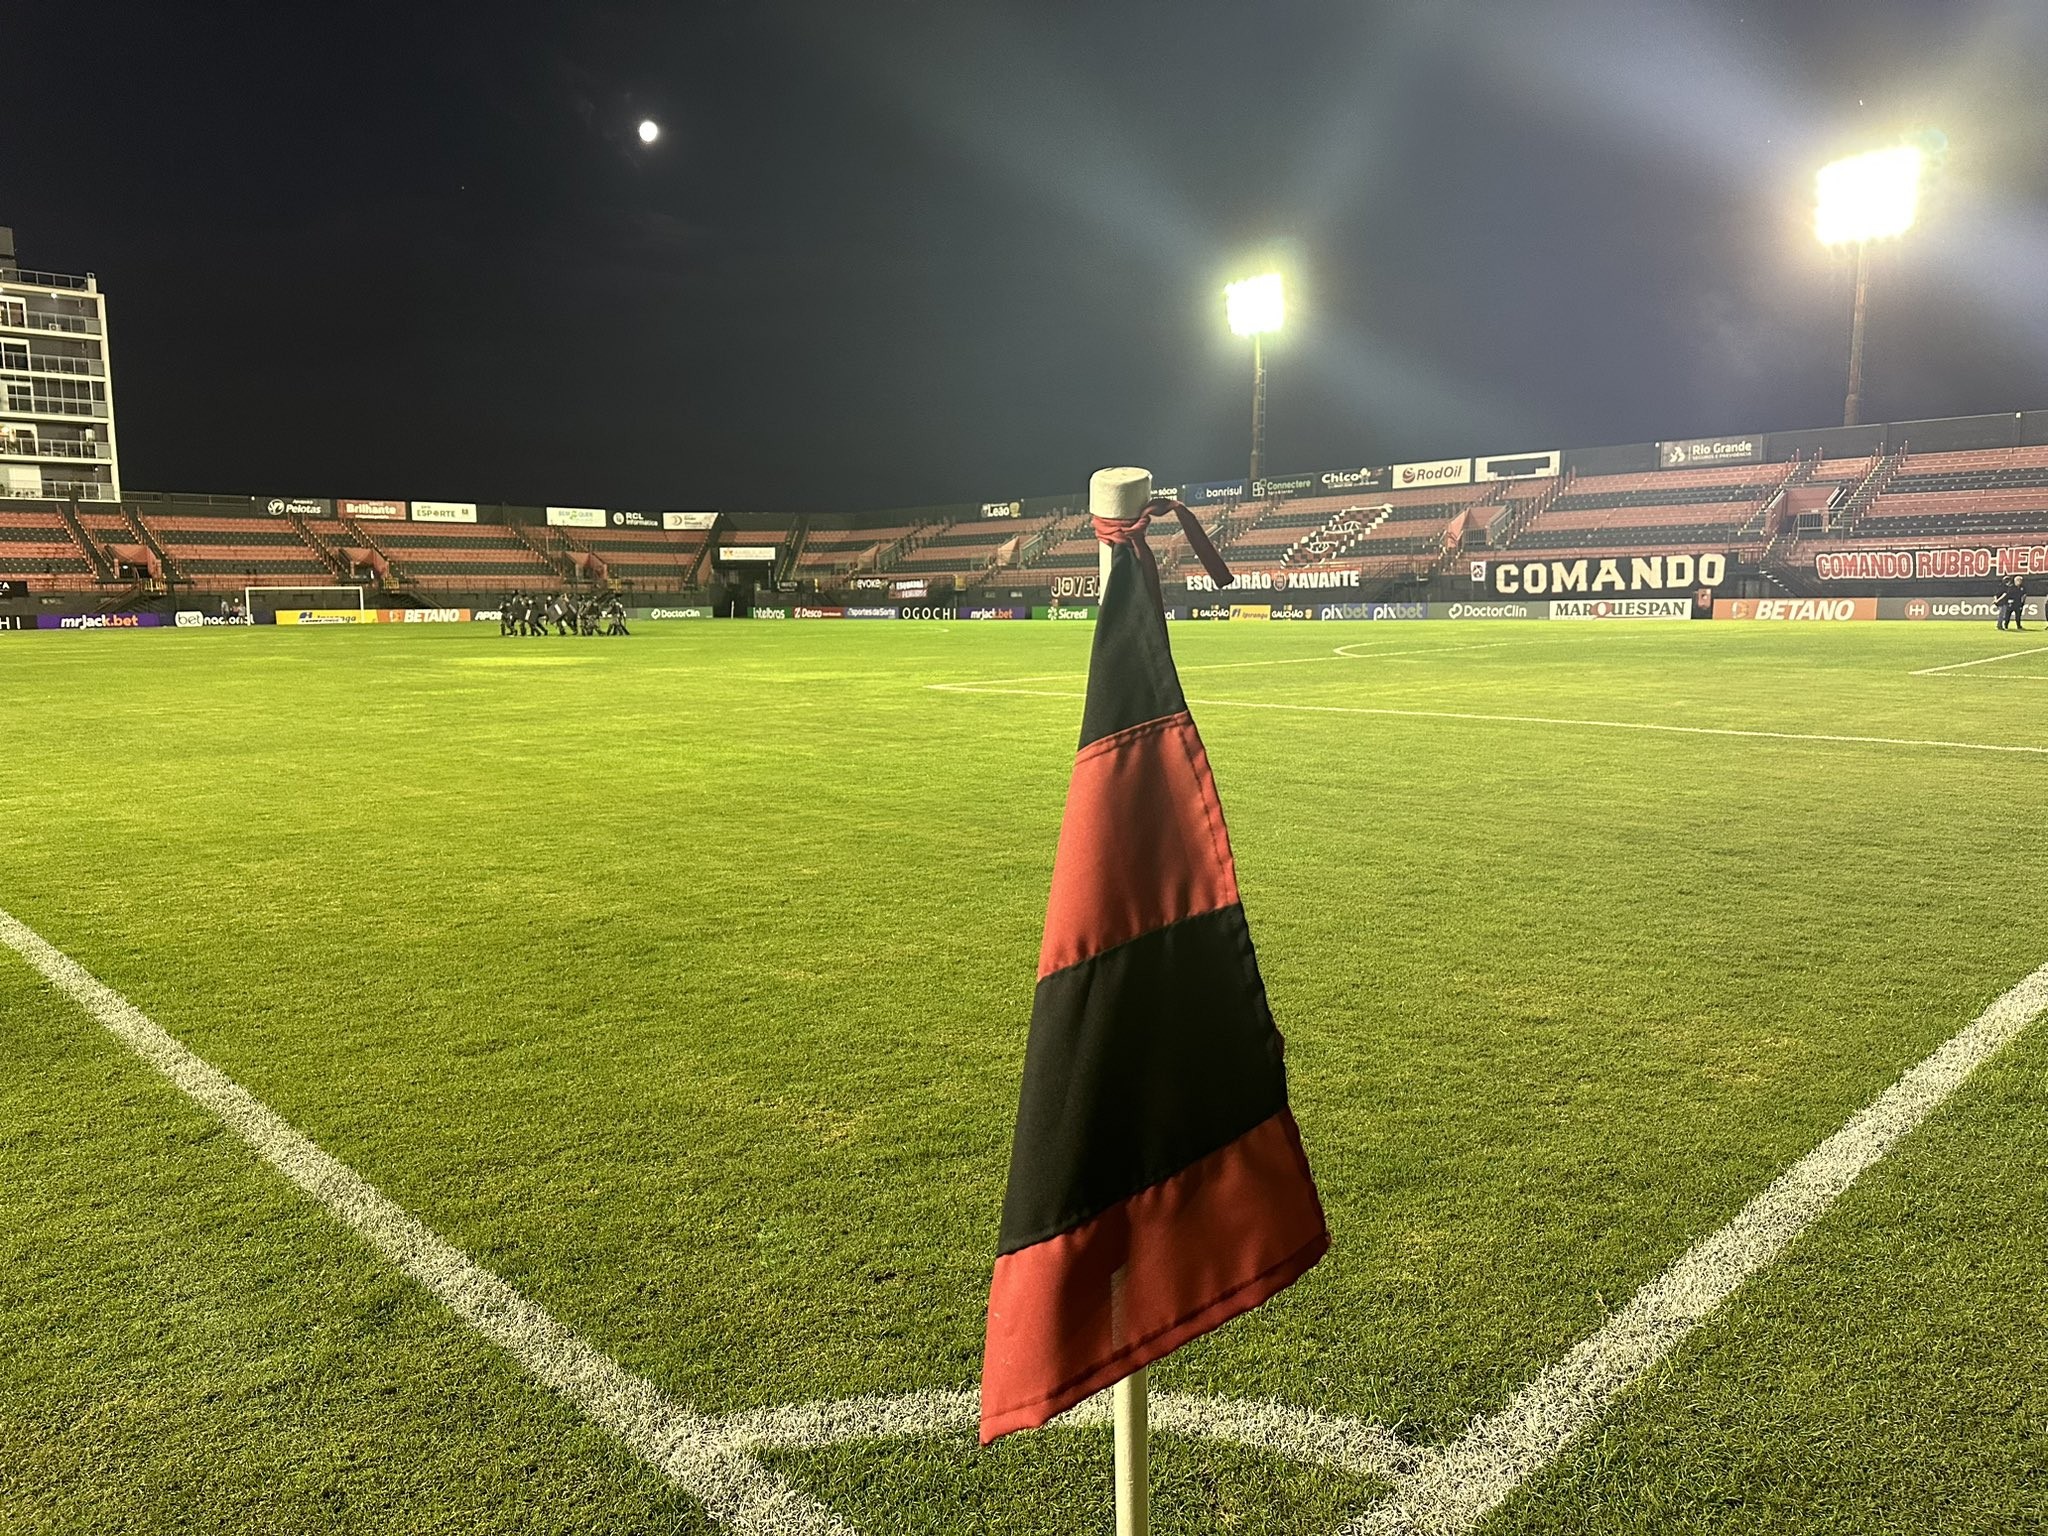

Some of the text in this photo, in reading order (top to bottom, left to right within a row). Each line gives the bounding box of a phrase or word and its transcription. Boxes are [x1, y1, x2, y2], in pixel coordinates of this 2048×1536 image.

[1692, 441, 1752, 455] Rio Grande
[1321, 472, 1359, 484] Chico
[1416, 466, 1462, 480] RodOil
[1206, 485, 1242, 498] banrisul
[1267, 480, 1311, 491] Connectere
[286, 504, 321, 514] Pelotas
[346, 503, 397, 515] Brilhante
[416, 509, 456, 518] ESPORTE
[625, 512, 644, 520] RCL
[1816, 545, 2048, 580] COMANDO RUBRO-NEG
[1496, 553, 1726, 594] COMANDO
[1186, 571, 1360, 592] ESQDRÃO XAVANTE
[661, 608, 700, 618] DoctorClin
[801, 608, 823, 618] Desco
[902, 607, 957, 620] OGOCHI
[970, 608, 1013, 620] mrjack.bet
[1058, 608, 1088, 619] Sicredi
[1321, 604, 1368, 621] pixbet
[1373, 603, 1423, 621] pixbet
[1463, 605, 1527, 618] DoctorClin
[1555, 601, 1685, 618] MARQUESPAN
[1754, 599, 1855, 621] BETANO
[1932, 601, 2038, 616] webmors
[60, 614, 138, 630] mrjack.bet
[403, 609, 460, 623] BETANO
